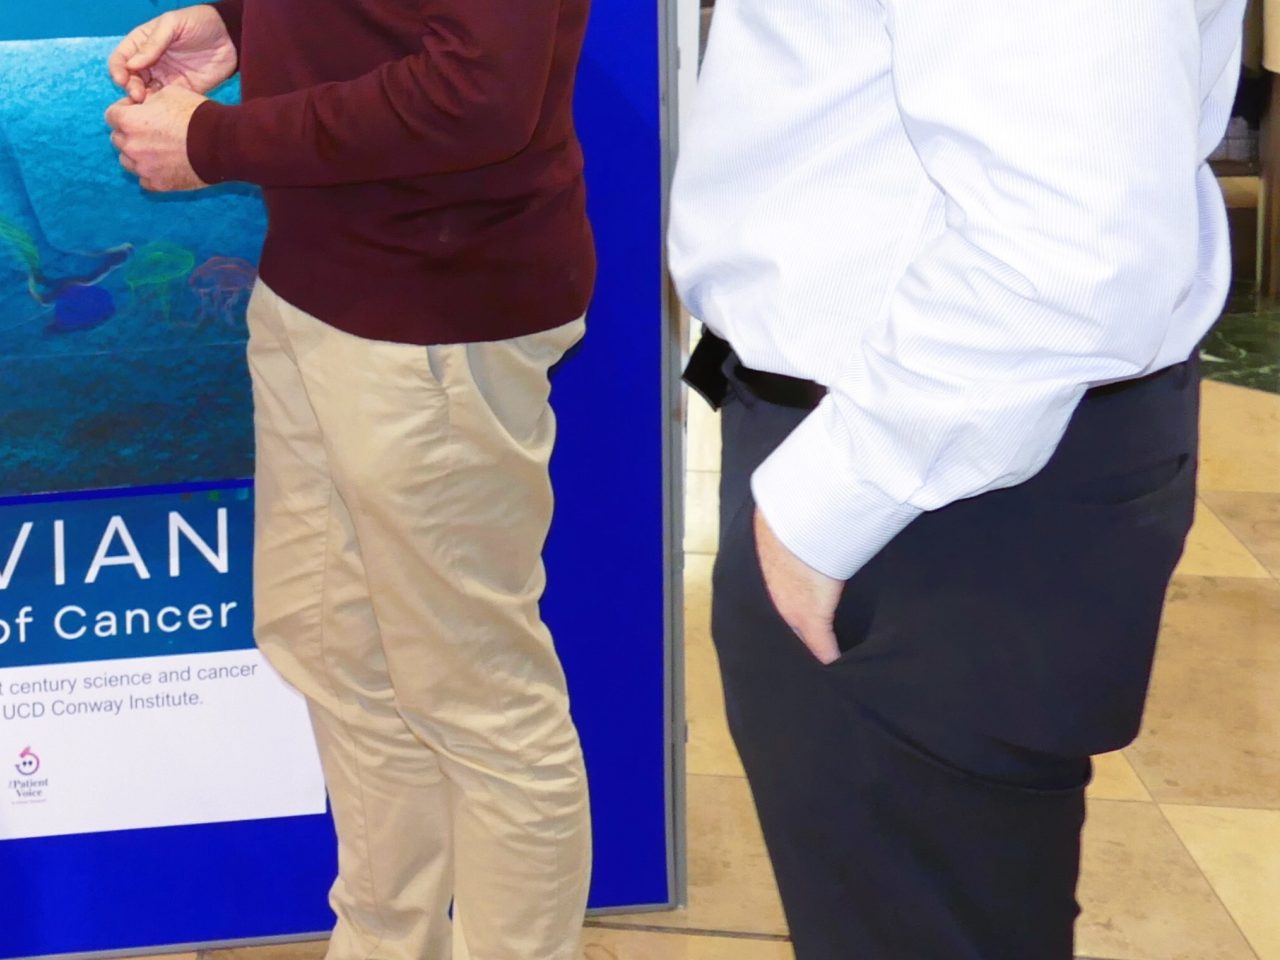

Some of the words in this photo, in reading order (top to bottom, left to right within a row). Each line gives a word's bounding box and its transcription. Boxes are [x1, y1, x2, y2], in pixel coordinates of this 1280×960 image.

[53, 600, 238, 640] Cancer
[9, 676, 78, 695] century
[83, 671, 152, 690] science
[158, 666, 191, 685] and
[196, 662, 259, 681] cancer
[2, 701, 45, 721] UCD
[51, 697, 123, 717] Conway
[128, 690, 204, 711] Institute.
[13, 778, 49, 789] Patient
[15, 788, 43, 798] Voice
